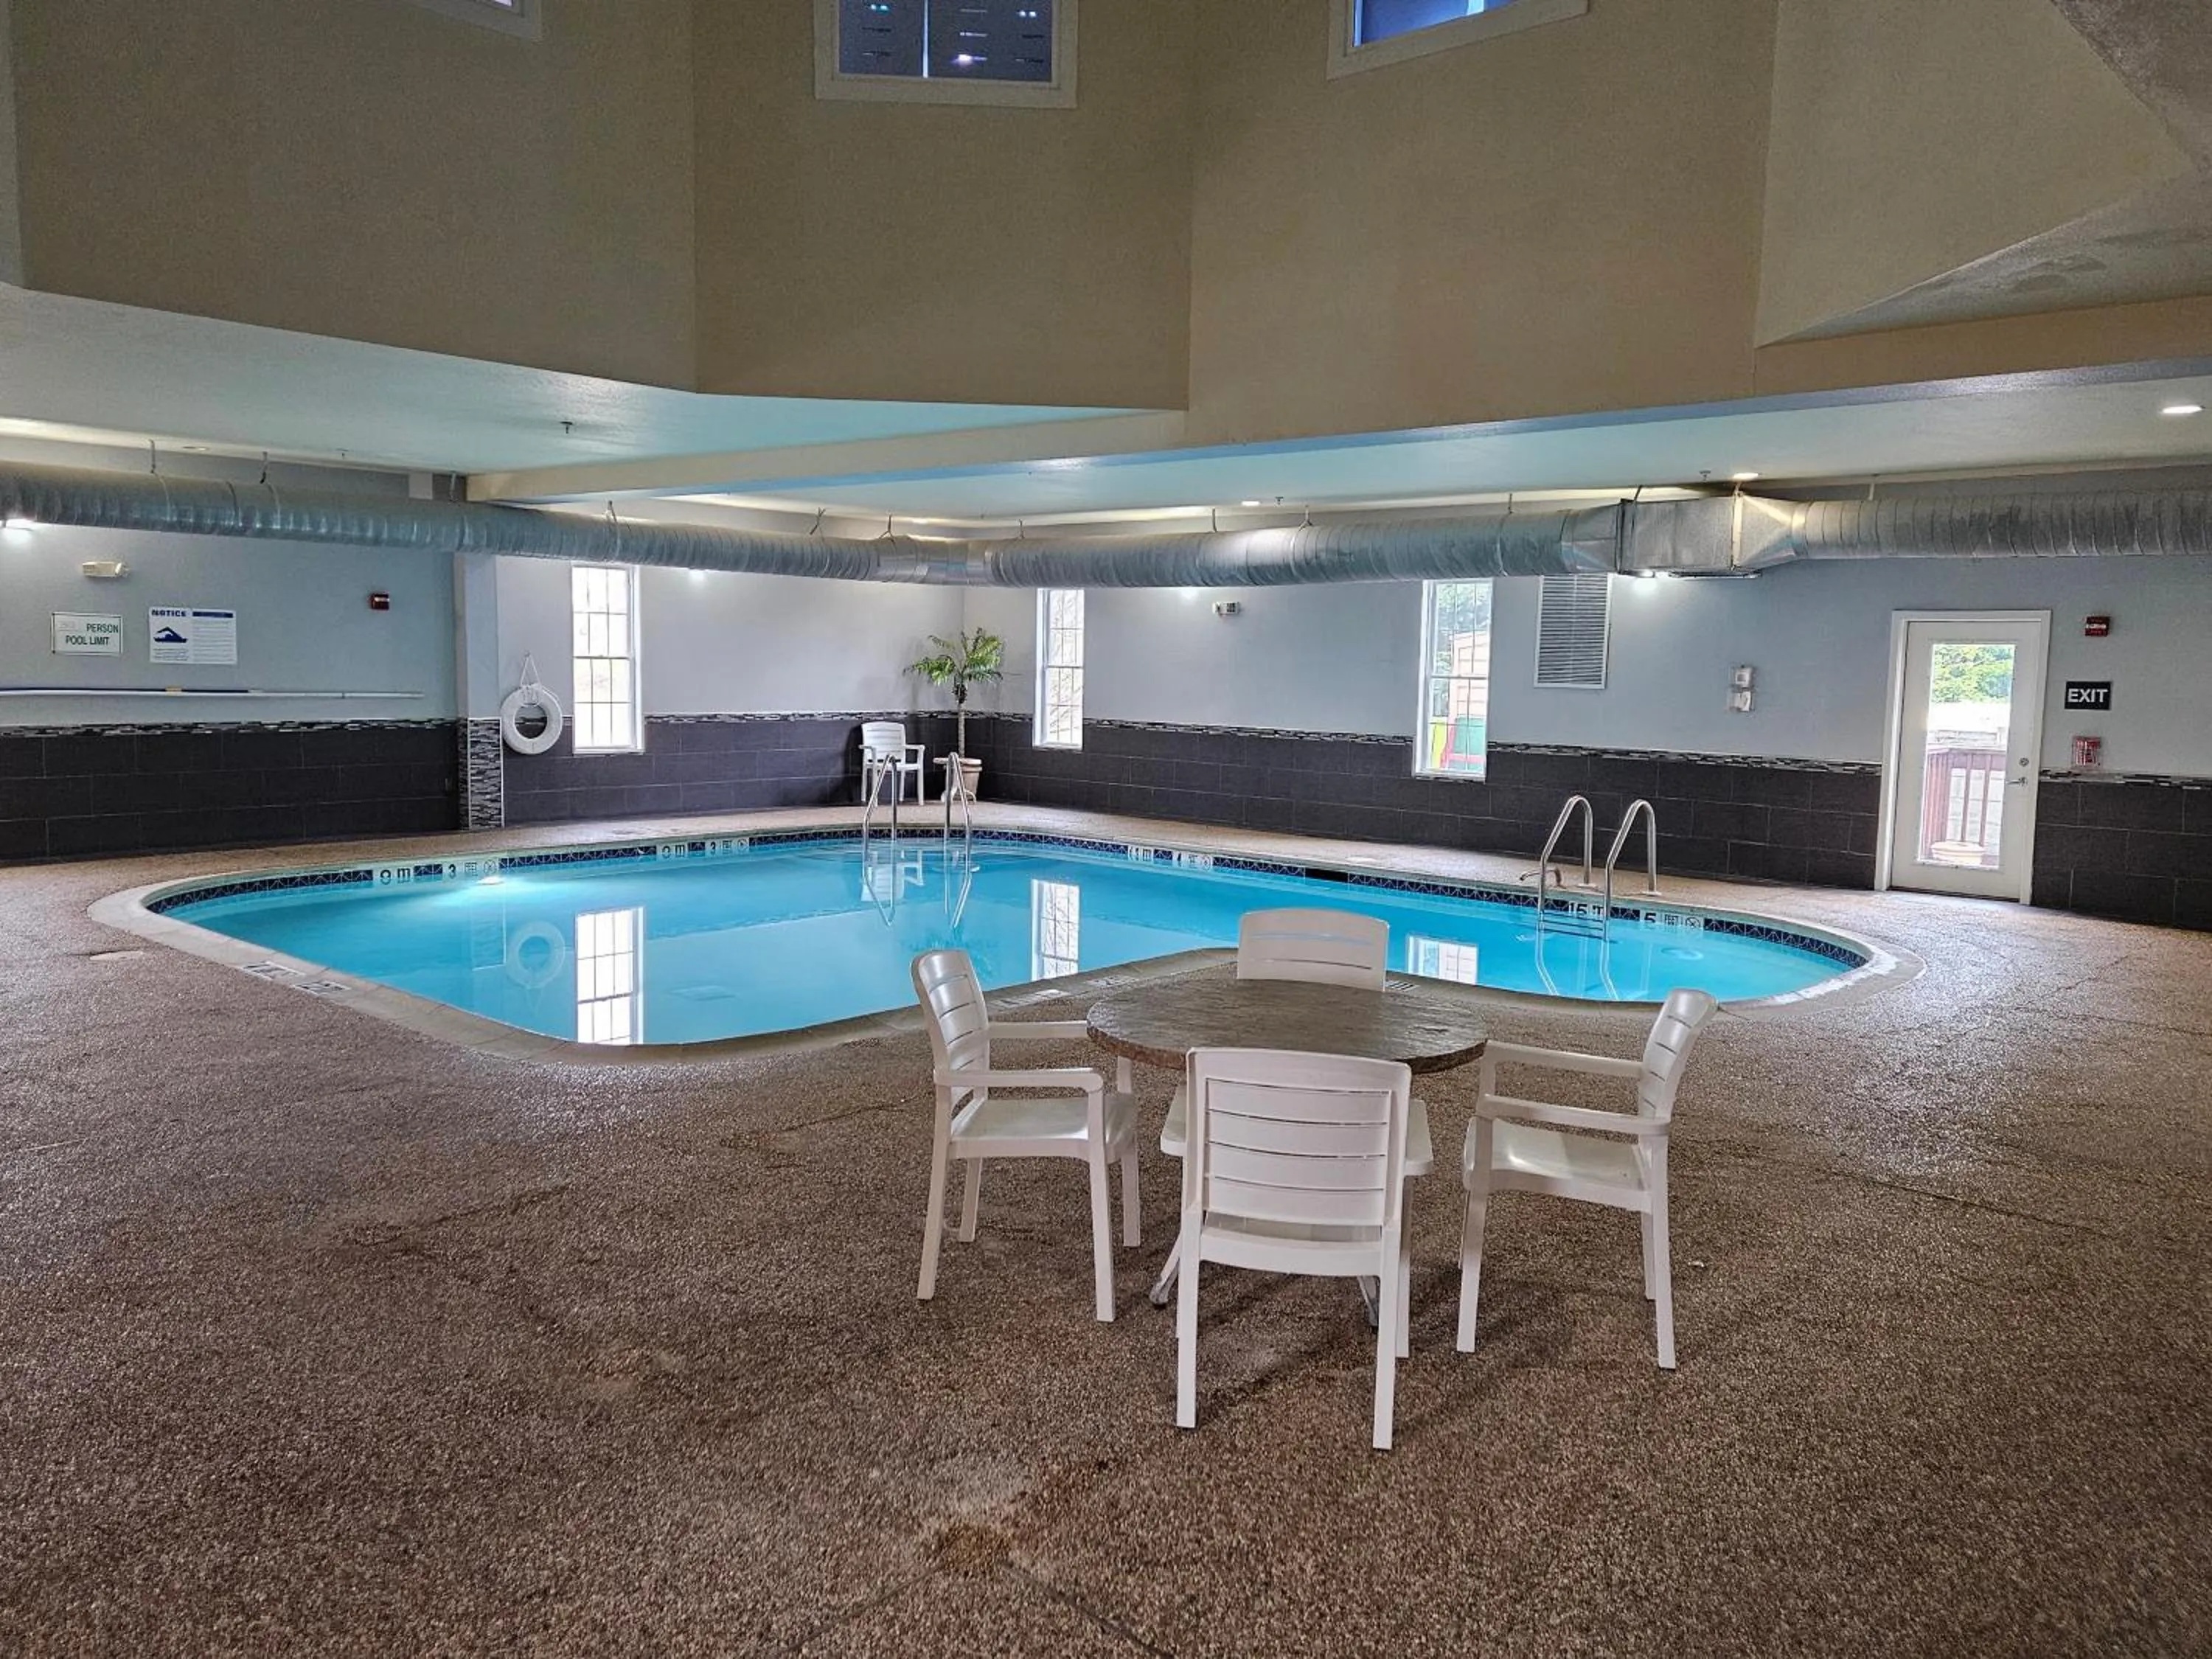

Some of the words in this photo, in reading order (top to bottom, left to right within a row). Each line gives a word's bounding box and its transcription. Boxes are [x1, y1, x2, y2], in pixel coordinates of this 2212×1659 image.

[152, 609, 187, 618] NOTICE
[87, 623, 119, 633] PERSON
[66, 635, 88, 645] POOL
[89, 636, 110, 646] LIMIT
[2067, 688, 2109, 703] EXIT
